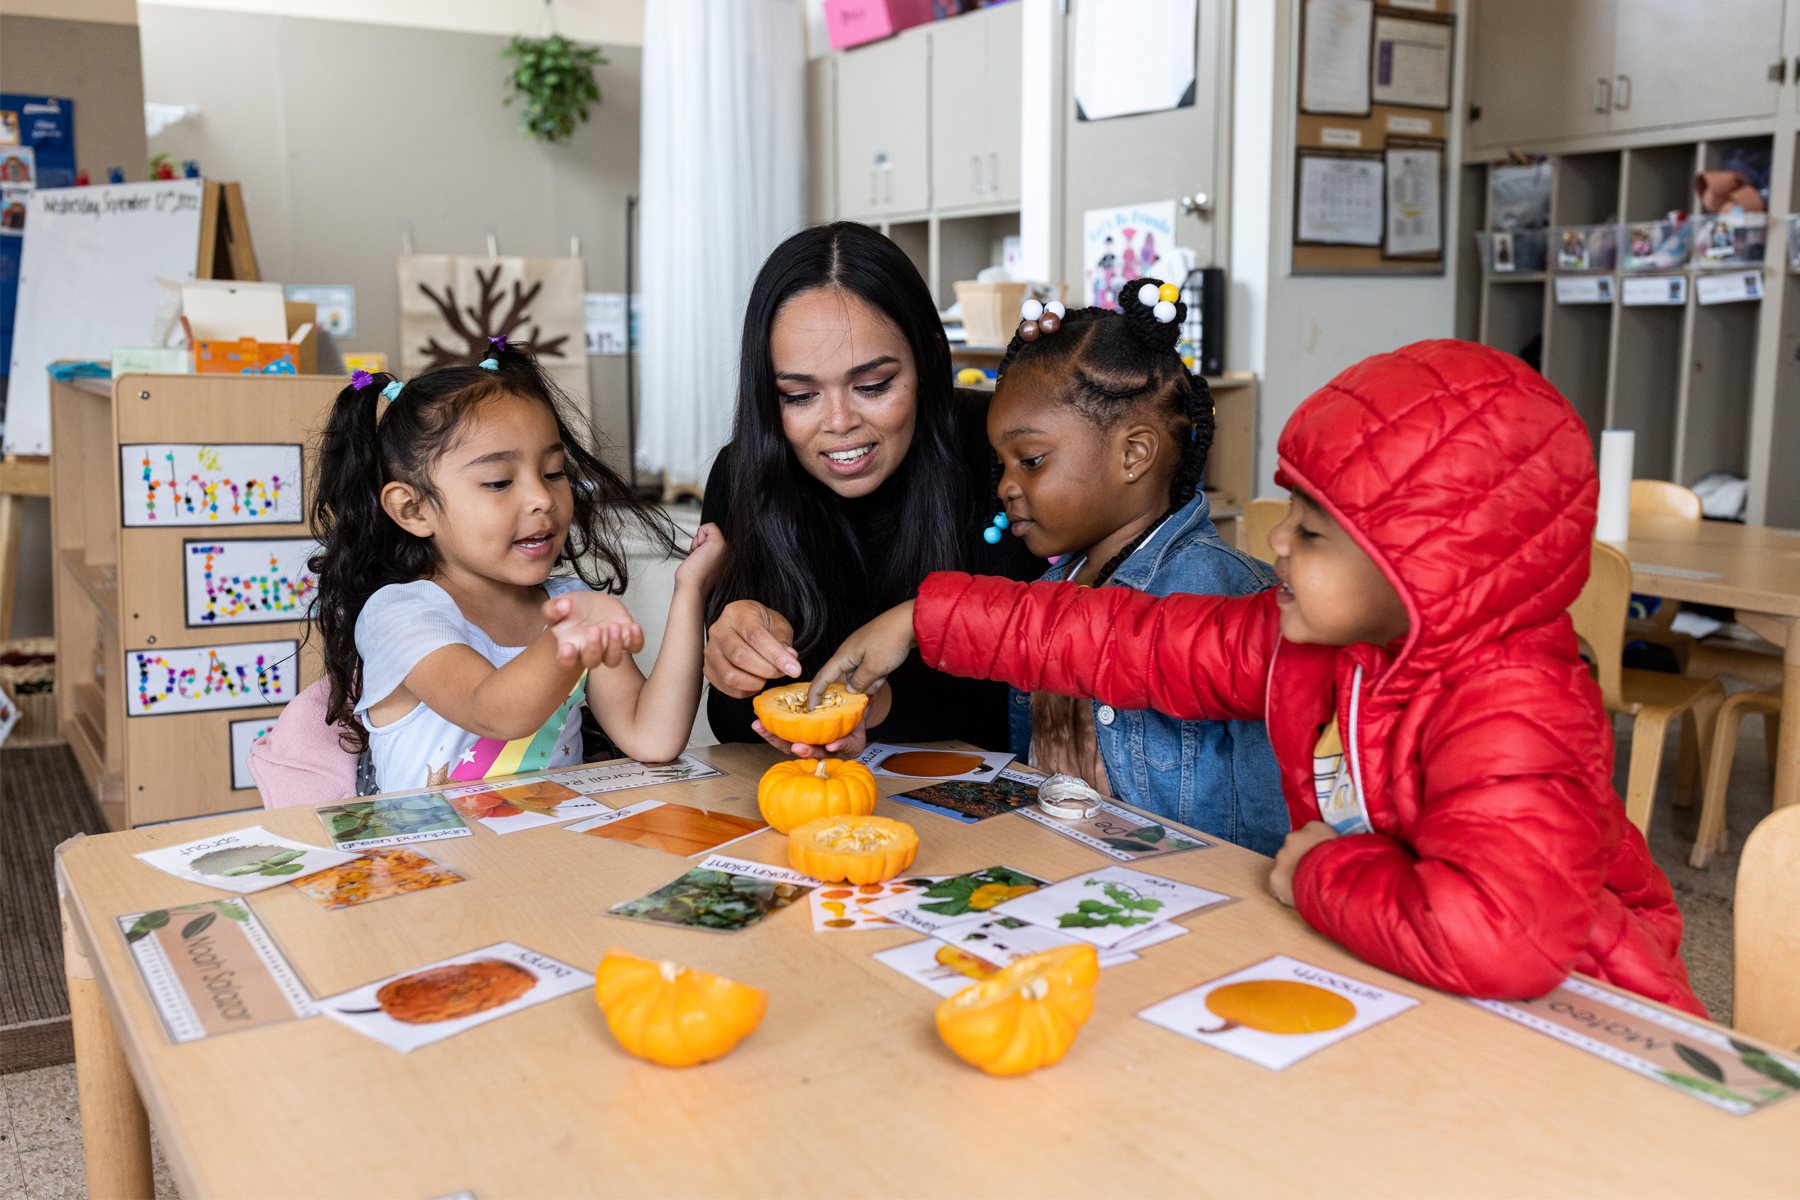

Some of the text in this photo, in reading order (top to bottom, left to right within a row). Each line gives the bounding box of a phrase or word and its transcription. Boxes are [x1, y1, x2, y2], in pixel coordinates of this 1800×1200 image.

[142, 449, 292, 520] Honor
[599, 809, 632, 822] skin
[179, 835, 240, 856] sprout
[341, 828, 467, 850] green pumpkin
[706, 858, 751, 873] plant
[183, 935, 252, 1022] Noah Salazar
[1292, 966, 1385, 1001] smooth
[1548, 1000, 1669, 1050] Mateo
